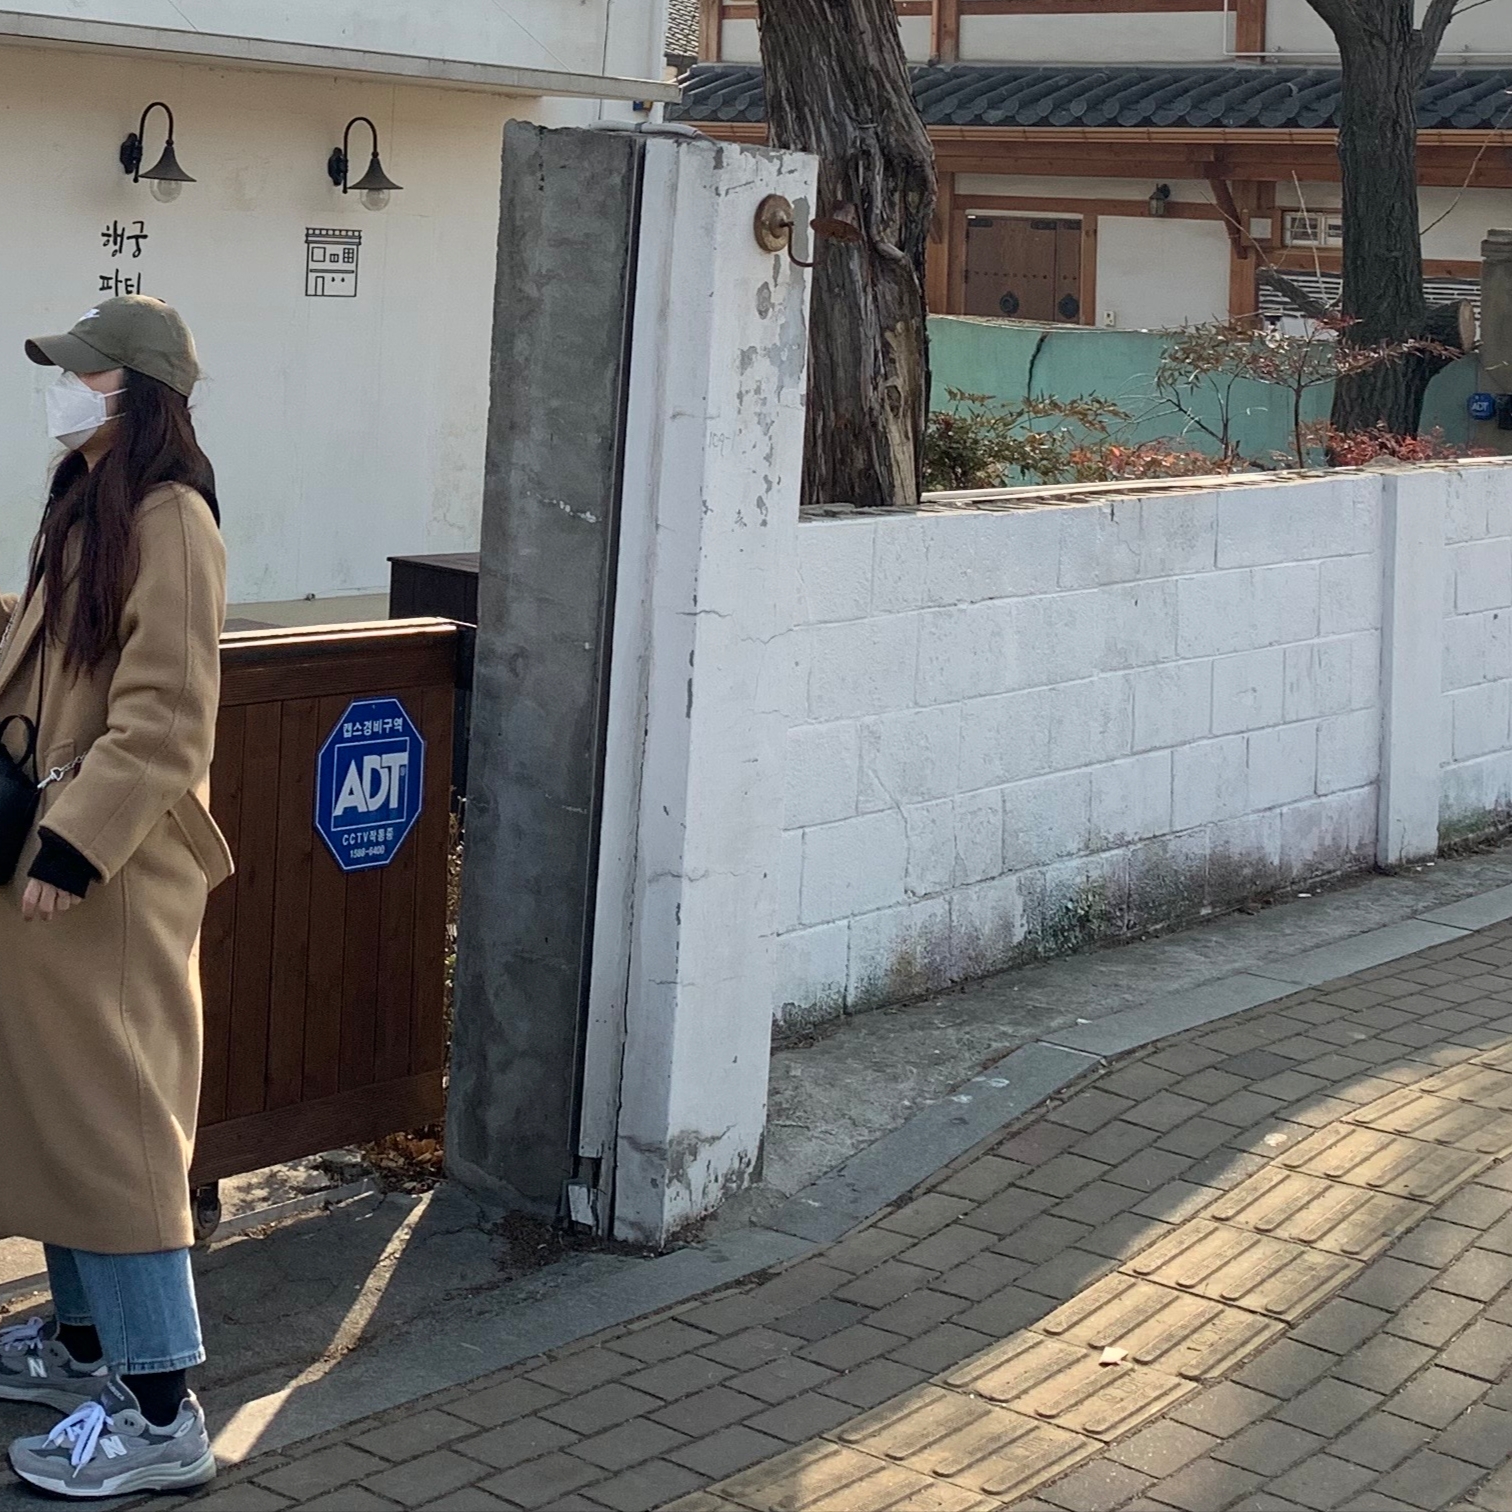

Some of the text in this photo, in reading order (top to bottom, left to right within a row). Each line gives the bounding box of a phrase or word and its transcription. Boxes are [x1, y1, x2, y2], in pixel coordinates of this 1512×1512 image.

[101, 220, 148, 258] 행궁
[1471, 401, 1490, 412] ADT
[343, 717, 403, 738] 캡스경비구역
[333, 752, 408, 816] ADT
[27, 1356, 48, 1378] N
[99, 1435, 128, 1459] N
